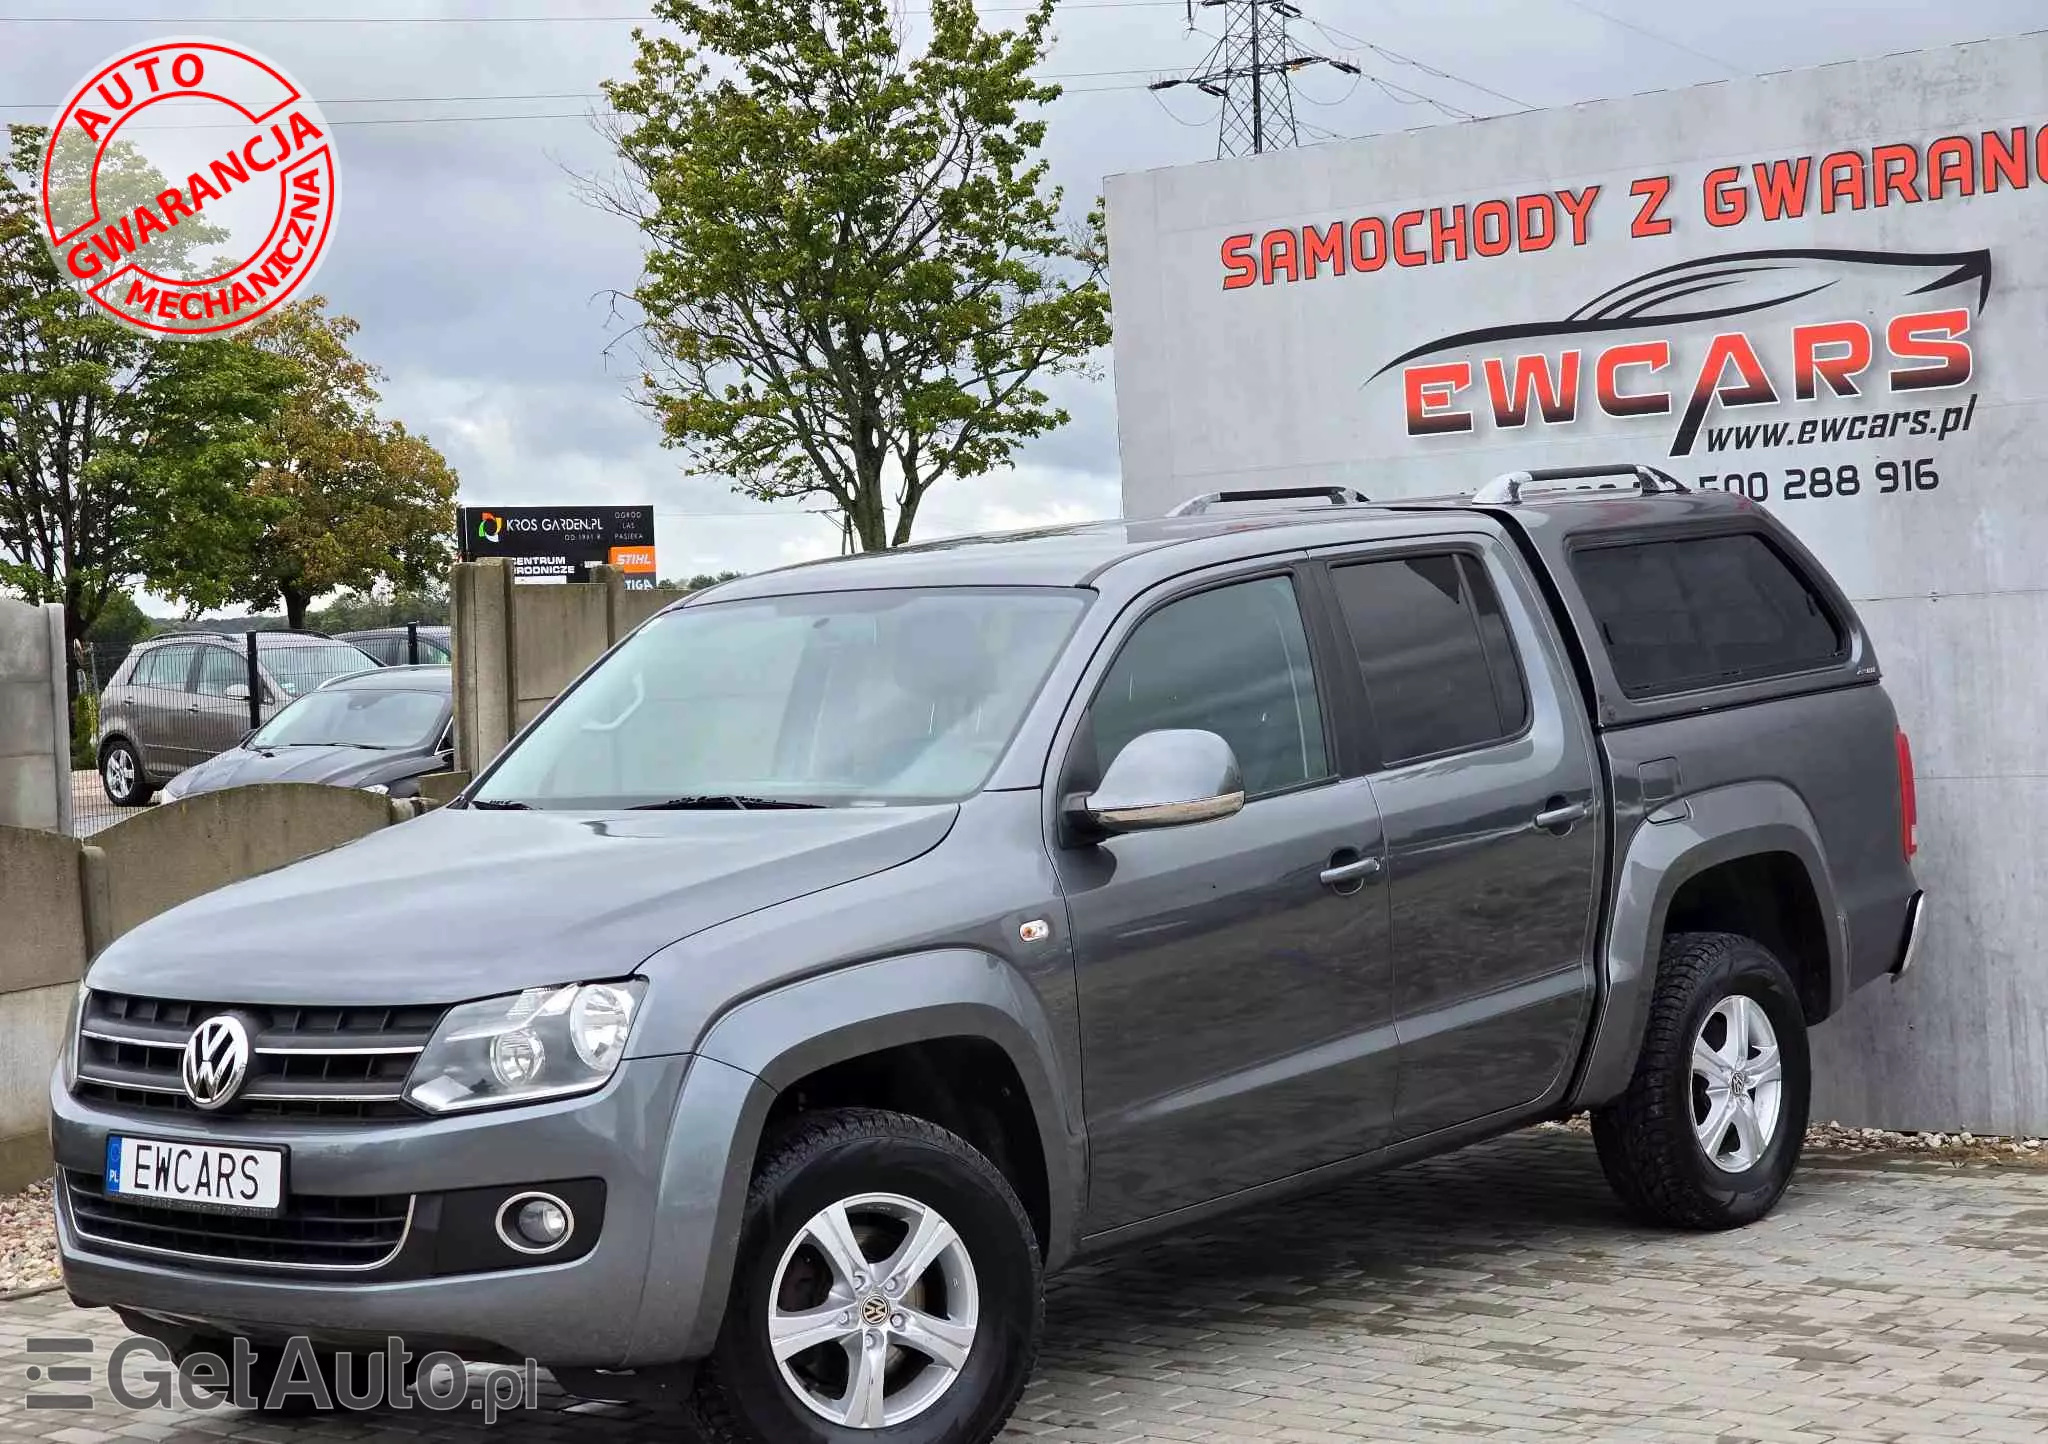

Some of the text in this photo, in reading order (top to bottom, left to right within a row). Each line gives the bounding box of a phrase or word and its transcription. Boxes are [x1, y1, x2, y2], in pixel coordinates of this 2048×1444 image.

[1221, 123, 2048, 291] SAMOCHODY Z GWARAN
[1403, 307, 1974, 458] EWCARS
[1704, 393, 1977, 454] www.ewcars.pl
[1784, 465, 1860, 500] 288
[1875, 458, 1939, 494] 916
[506, 518, 538, 532] KROS
[616, 554, 651, 565] STIHL
[109, 1170, 119, 1183] PL
[134, 1144, 260, 1200] EWCARS
